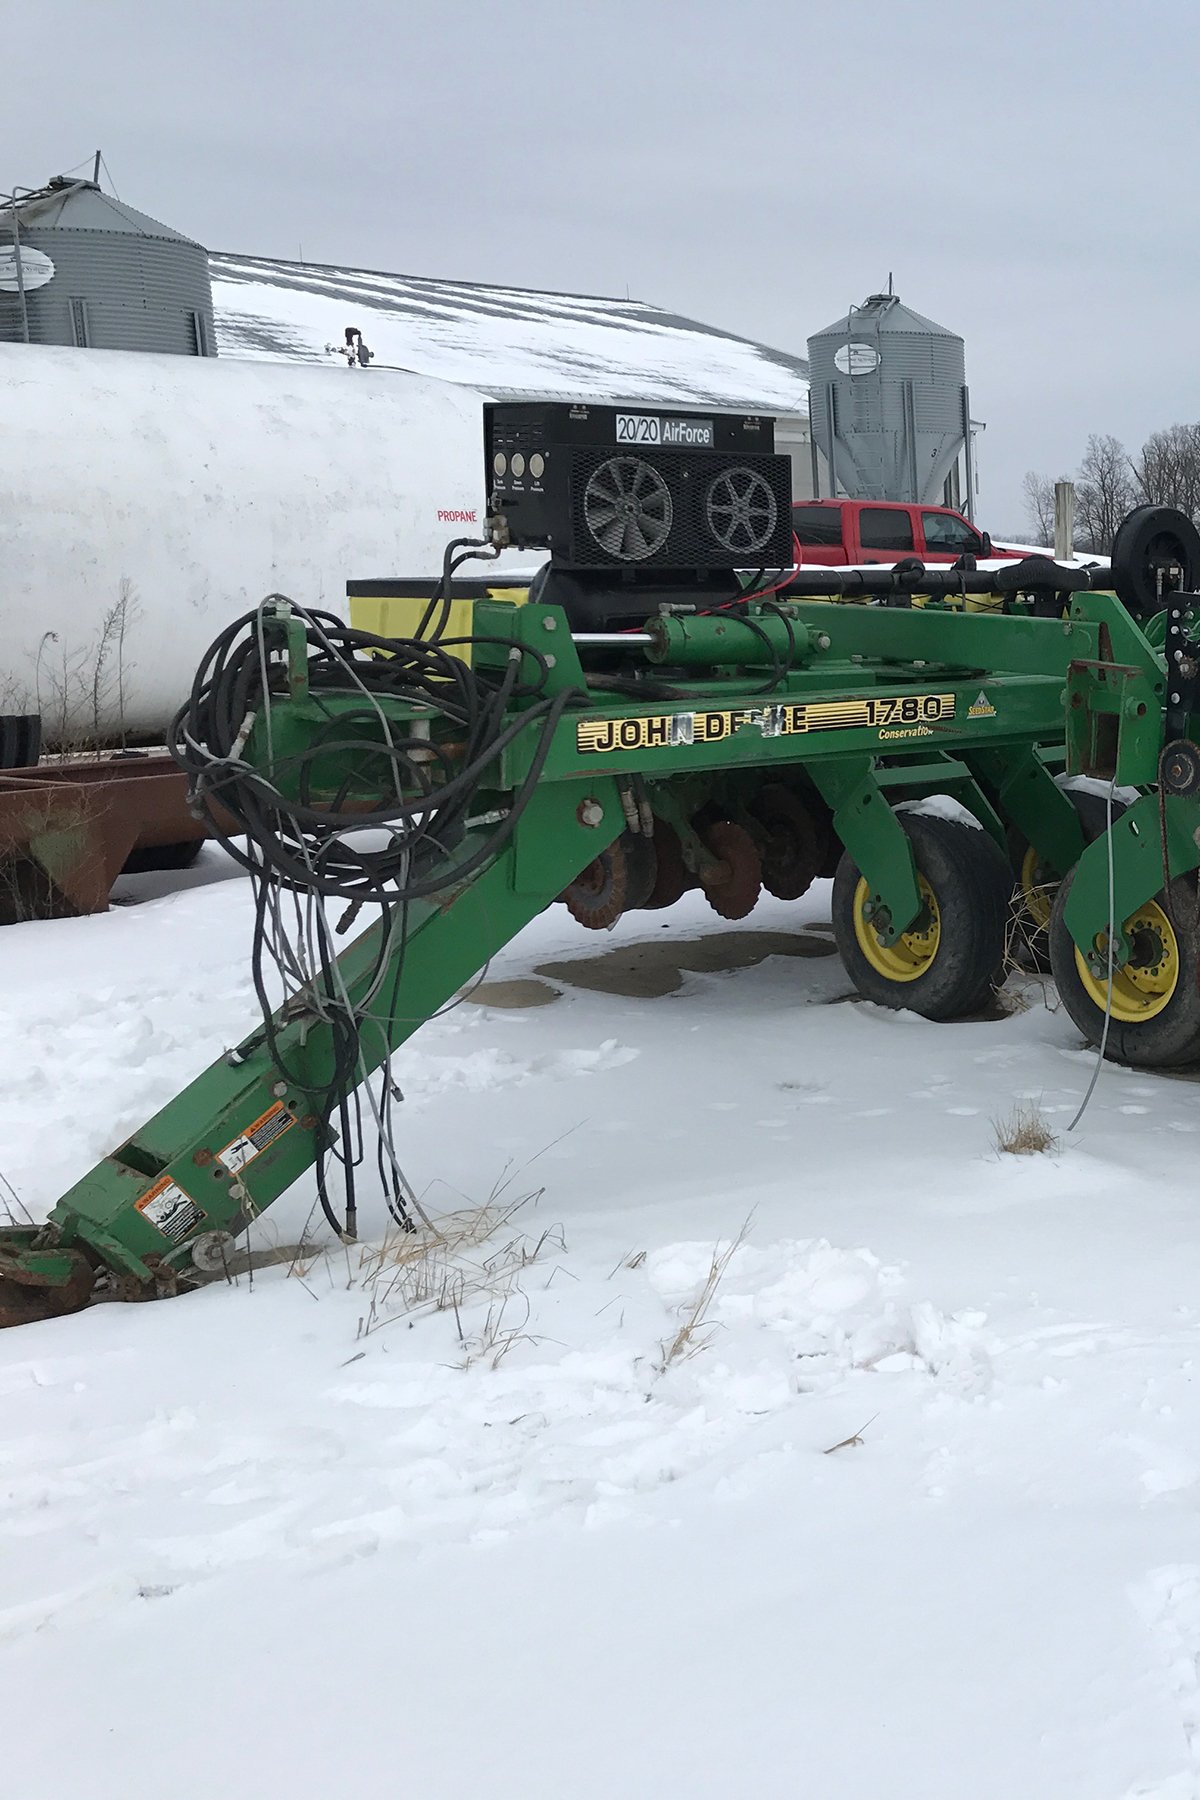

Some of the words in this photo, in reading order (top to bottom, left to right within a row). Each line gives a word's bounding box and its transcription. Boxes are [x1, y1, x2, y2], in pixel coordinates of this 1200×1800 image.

[617, 416, 659, 442] 20/20
[662, 421, 711, 444] AirForce
[437, 510, 478, 522] PROPANE
[865, 695, 943, 725] 1780
